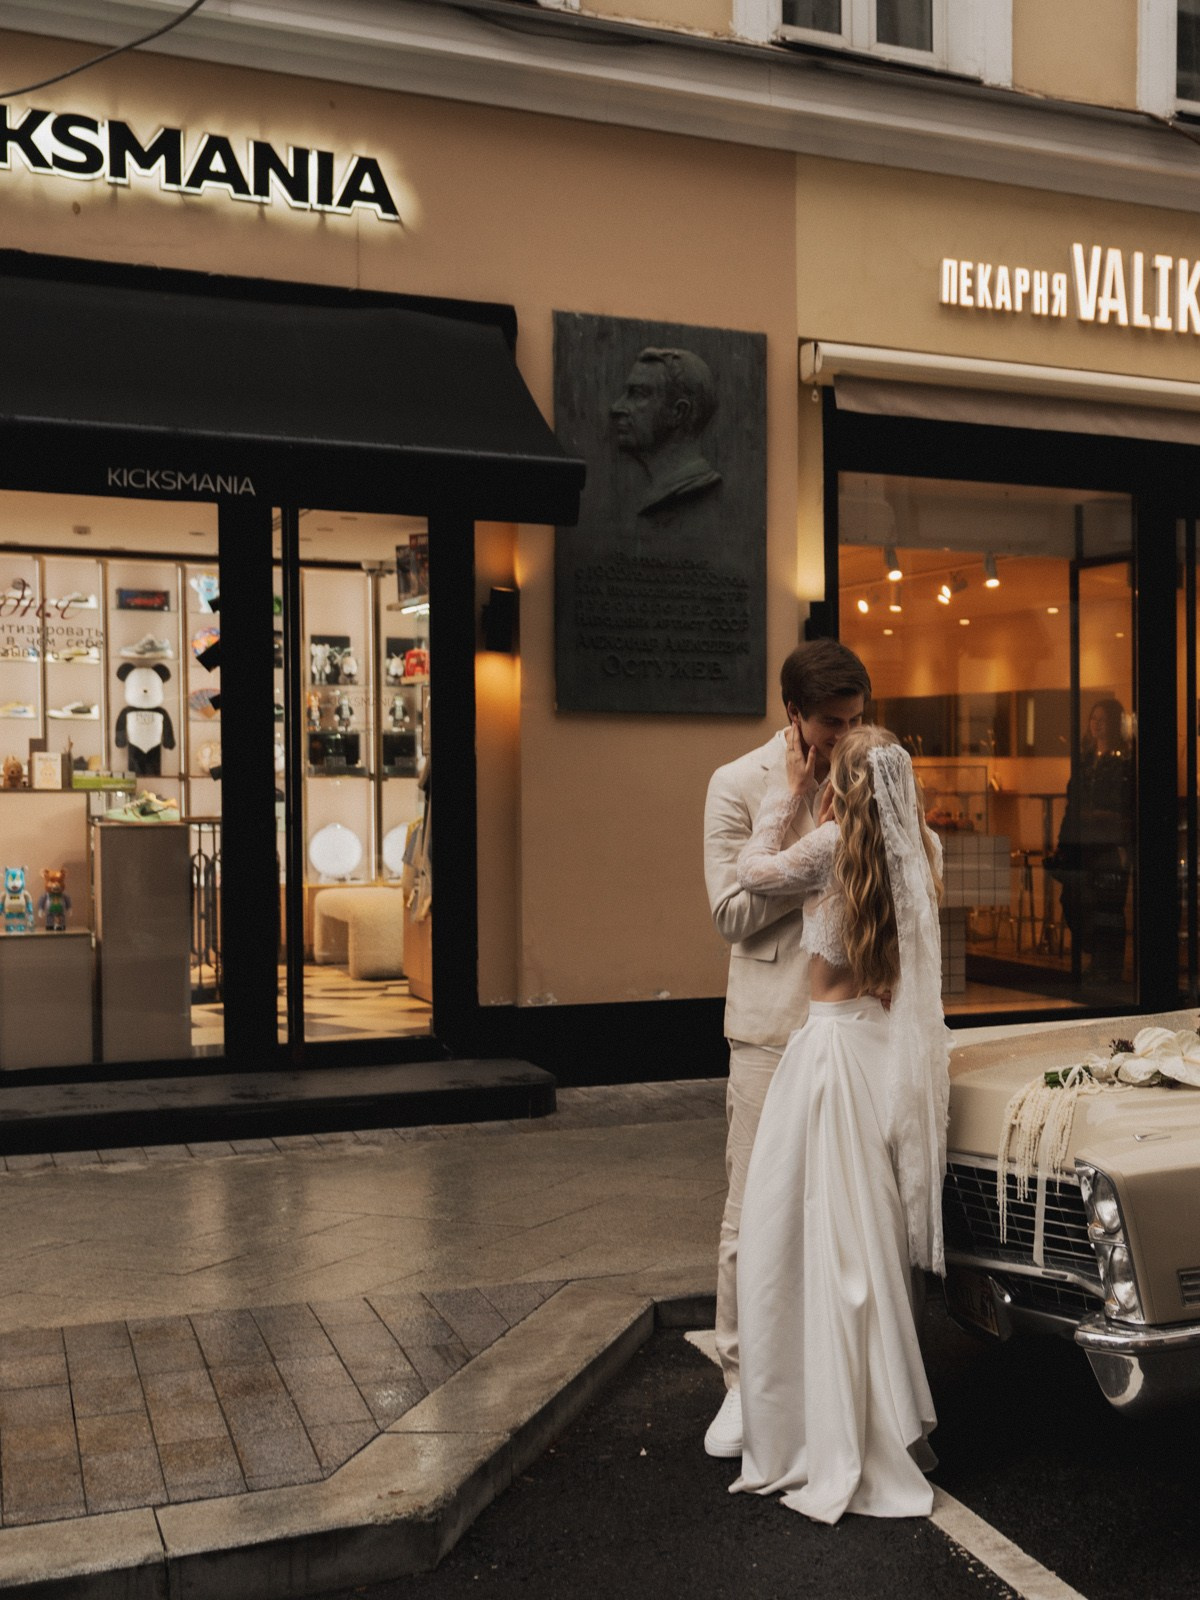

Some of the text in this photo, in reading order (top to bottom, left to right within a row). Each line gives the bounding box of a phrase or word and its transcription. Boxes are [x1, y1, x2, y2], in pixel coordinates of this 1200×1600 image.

[0, 104, 400, 220] KSMANIA
[941, 257, 1067, 318] ПЕКАРНЯ
[107, 467, 256, 497] KICKSMANIA
